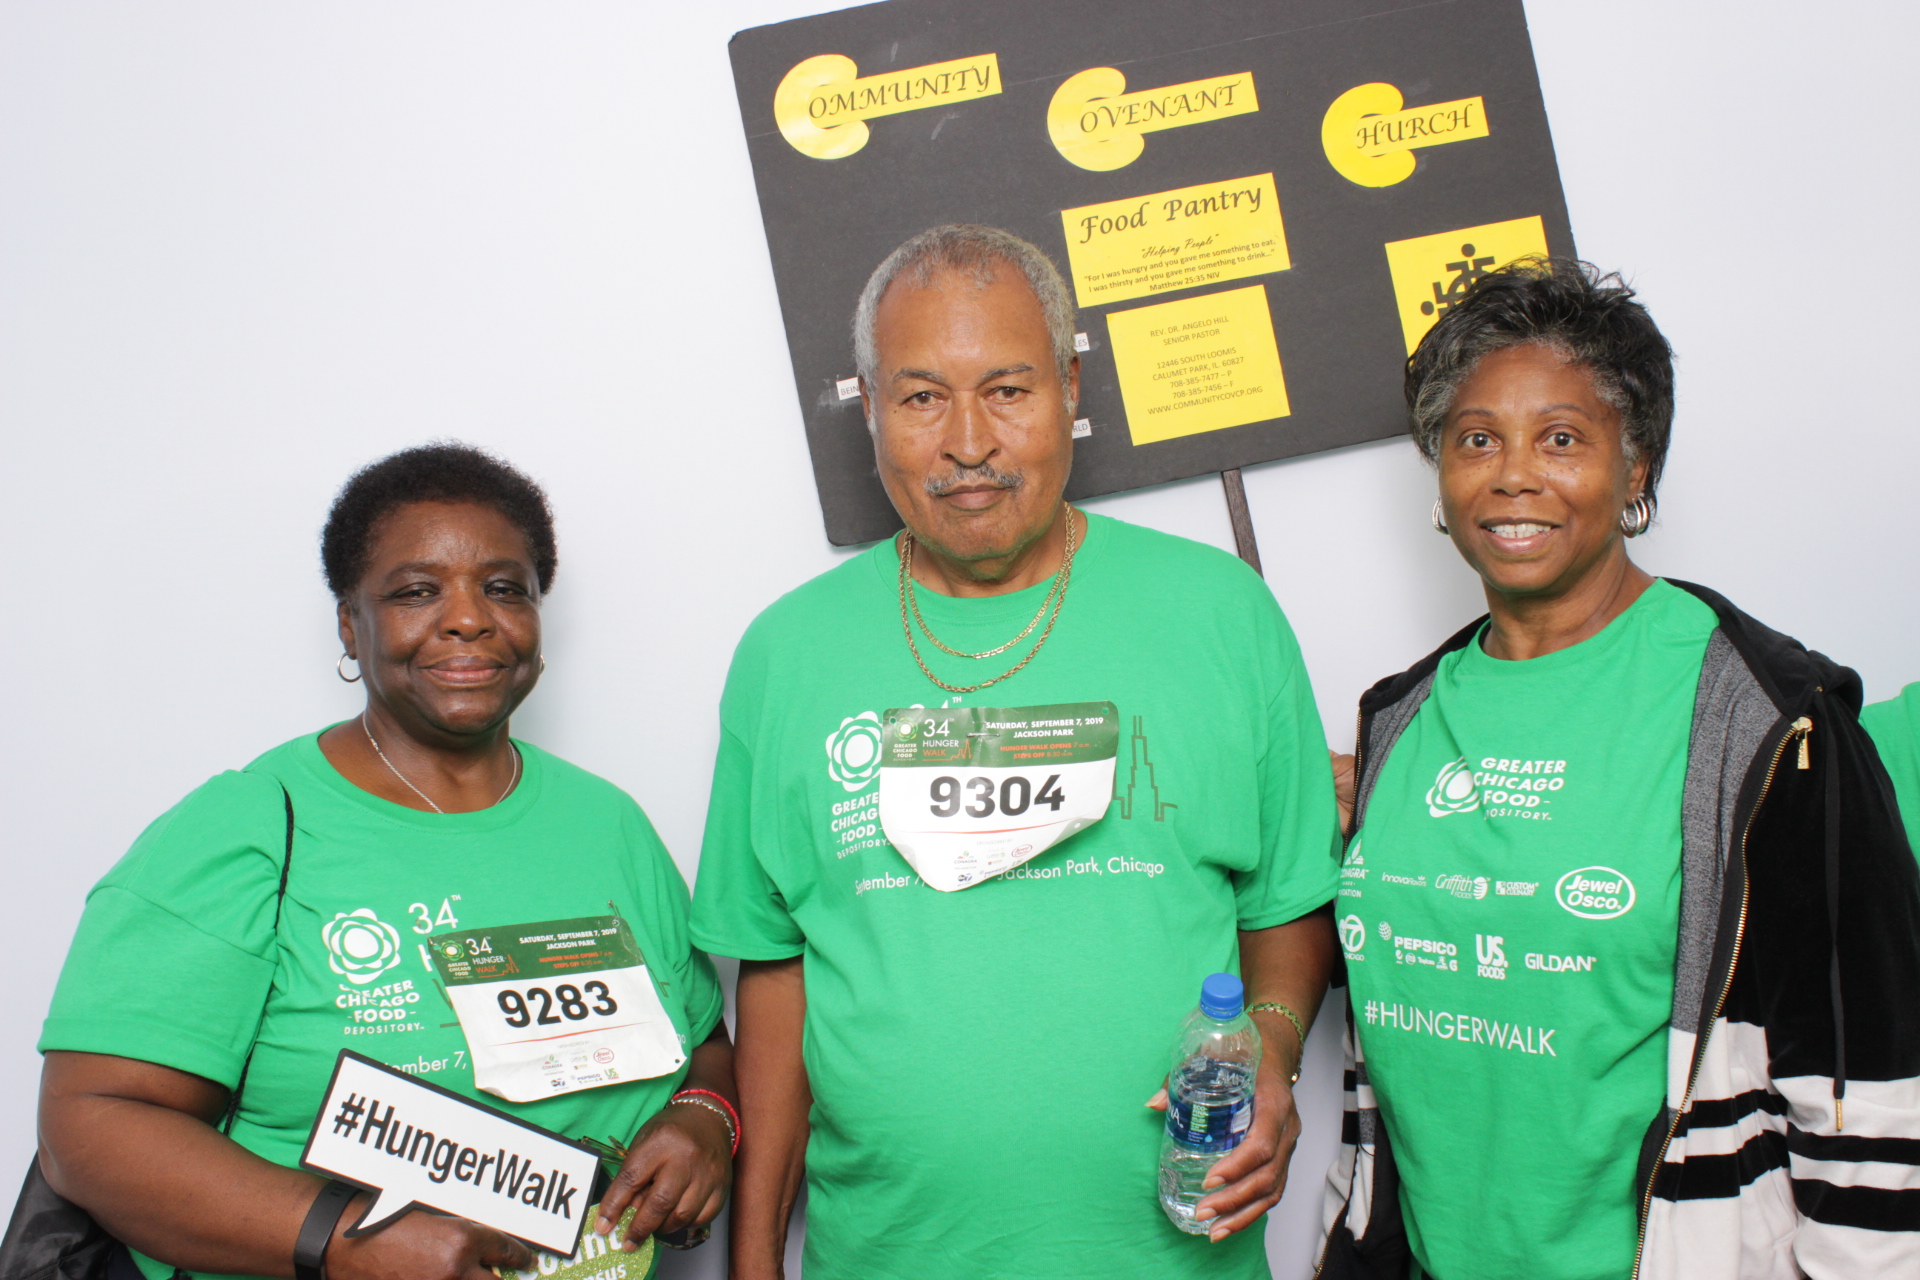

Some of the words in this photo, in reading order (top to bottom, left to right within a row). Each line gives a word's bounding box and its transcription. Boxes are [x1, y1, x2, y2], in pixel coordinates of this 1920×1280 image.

[1080, 202, 1150, 244] Food
[1164, 187, 1262, 222] Pantry
[1106, 270, 1121, 278] was
[1122, 265, 1148, 275] hungry
[1149, 261, 1164, 269] and
[1165, 258, 1179, 268] you
[1180, 254, 1198, 265] gave
[1212, 245, 1251, 255] something
[1261, 239, 1276, 247] eat.
[1093, 284, 1108, 292] was
[1109, 279, 1133, 288] thirsty
[1134, 275, 1149, 283] and
[1150, 273, 1164, 282] you
[1165, 268, 1183, 278] gave
[1184, 266, 1196, 274] me
[1197, 258, 1237, 270] something
[1149, 280, 1183, 291] Matthew
[1184, 275, 1205, 284] 25:35
[1206, 271, 1220, 279] NIV
[1150, 329, 1167, 337] REV.
[1167, 325, 1180, 334] DR.
[1182, 319, 1212, 331] ANGELO
[1213, 316, 1230, 325] HILL
[1163, 334, 1191, 346] SENIOR
[1192, 328, 1221, 340] PASTOR
[1152, 368, 1188, 381] CALUMET
[1189, 364, 1211, 373] PARK,
[1222, 356, 1244, 367] 60827
[1156, 358, 1180, 370] 12446
[1180, 353, 1206, 365] SOUTH
[1207, 347, 1237, 359] LOOMIS
[841, 385, 860, 396] BEIN
[1170, 372, 1219, 389] 708-385-7477
[1147, 386, 1264, 415] WWW.COMMUNITYCOVCP.ORG
[1172, 383, 1222, 399] 708-385-7456
[1073, 423, 1088, 433] RLD
[986, 721, 1029, 730] SATURDAY,
[1031, 719, 1074, 728] SEPTEMBER
[1076, 718, 1083, 726] 7,
[1085, 717, 1104, 725] 2019
[1013, 730, 1051, 738] JACKSON
[1052, 729, 1074, 737] PARK
[922, 740, 960, 748] HUNGER
[1480, 757, 1567, 774] GREATER
[1473, 771, 1565, 792] CHICAGO
[832, 792, 879, 816] GREATE
[930, 773, 1066, 819] 9304
[831, 807, 878, 832] CHICAG
[1066, 856, 1103, 875] Park,
[1107, 856, 1165, 878] Chicago
[1565, 875, 1624, 895] Jewel
[519, 934, 557, 944] SATURDAY,
[557, 930, 593, 940] SEPTEMBER
[601, 928, 617, 936] 2019
[546, 941, 578, 950] JACKSON
[578, 939, 596, 947] PARK
[1394, 935, 1457, 957] PEPSICO
[472, 955, 506, 965] HUNGER
[475, 965, 498, 973] WALK
[1477, 964, 1506, 980] FOODS
[497, 980, 618, 1029] 9283
[1364, 1000, 1557, 1057] #HUNGERWALK
[453, 1050, 467, 1070] 7,
[332, 1092, 578, 1220] #HungerWalk
